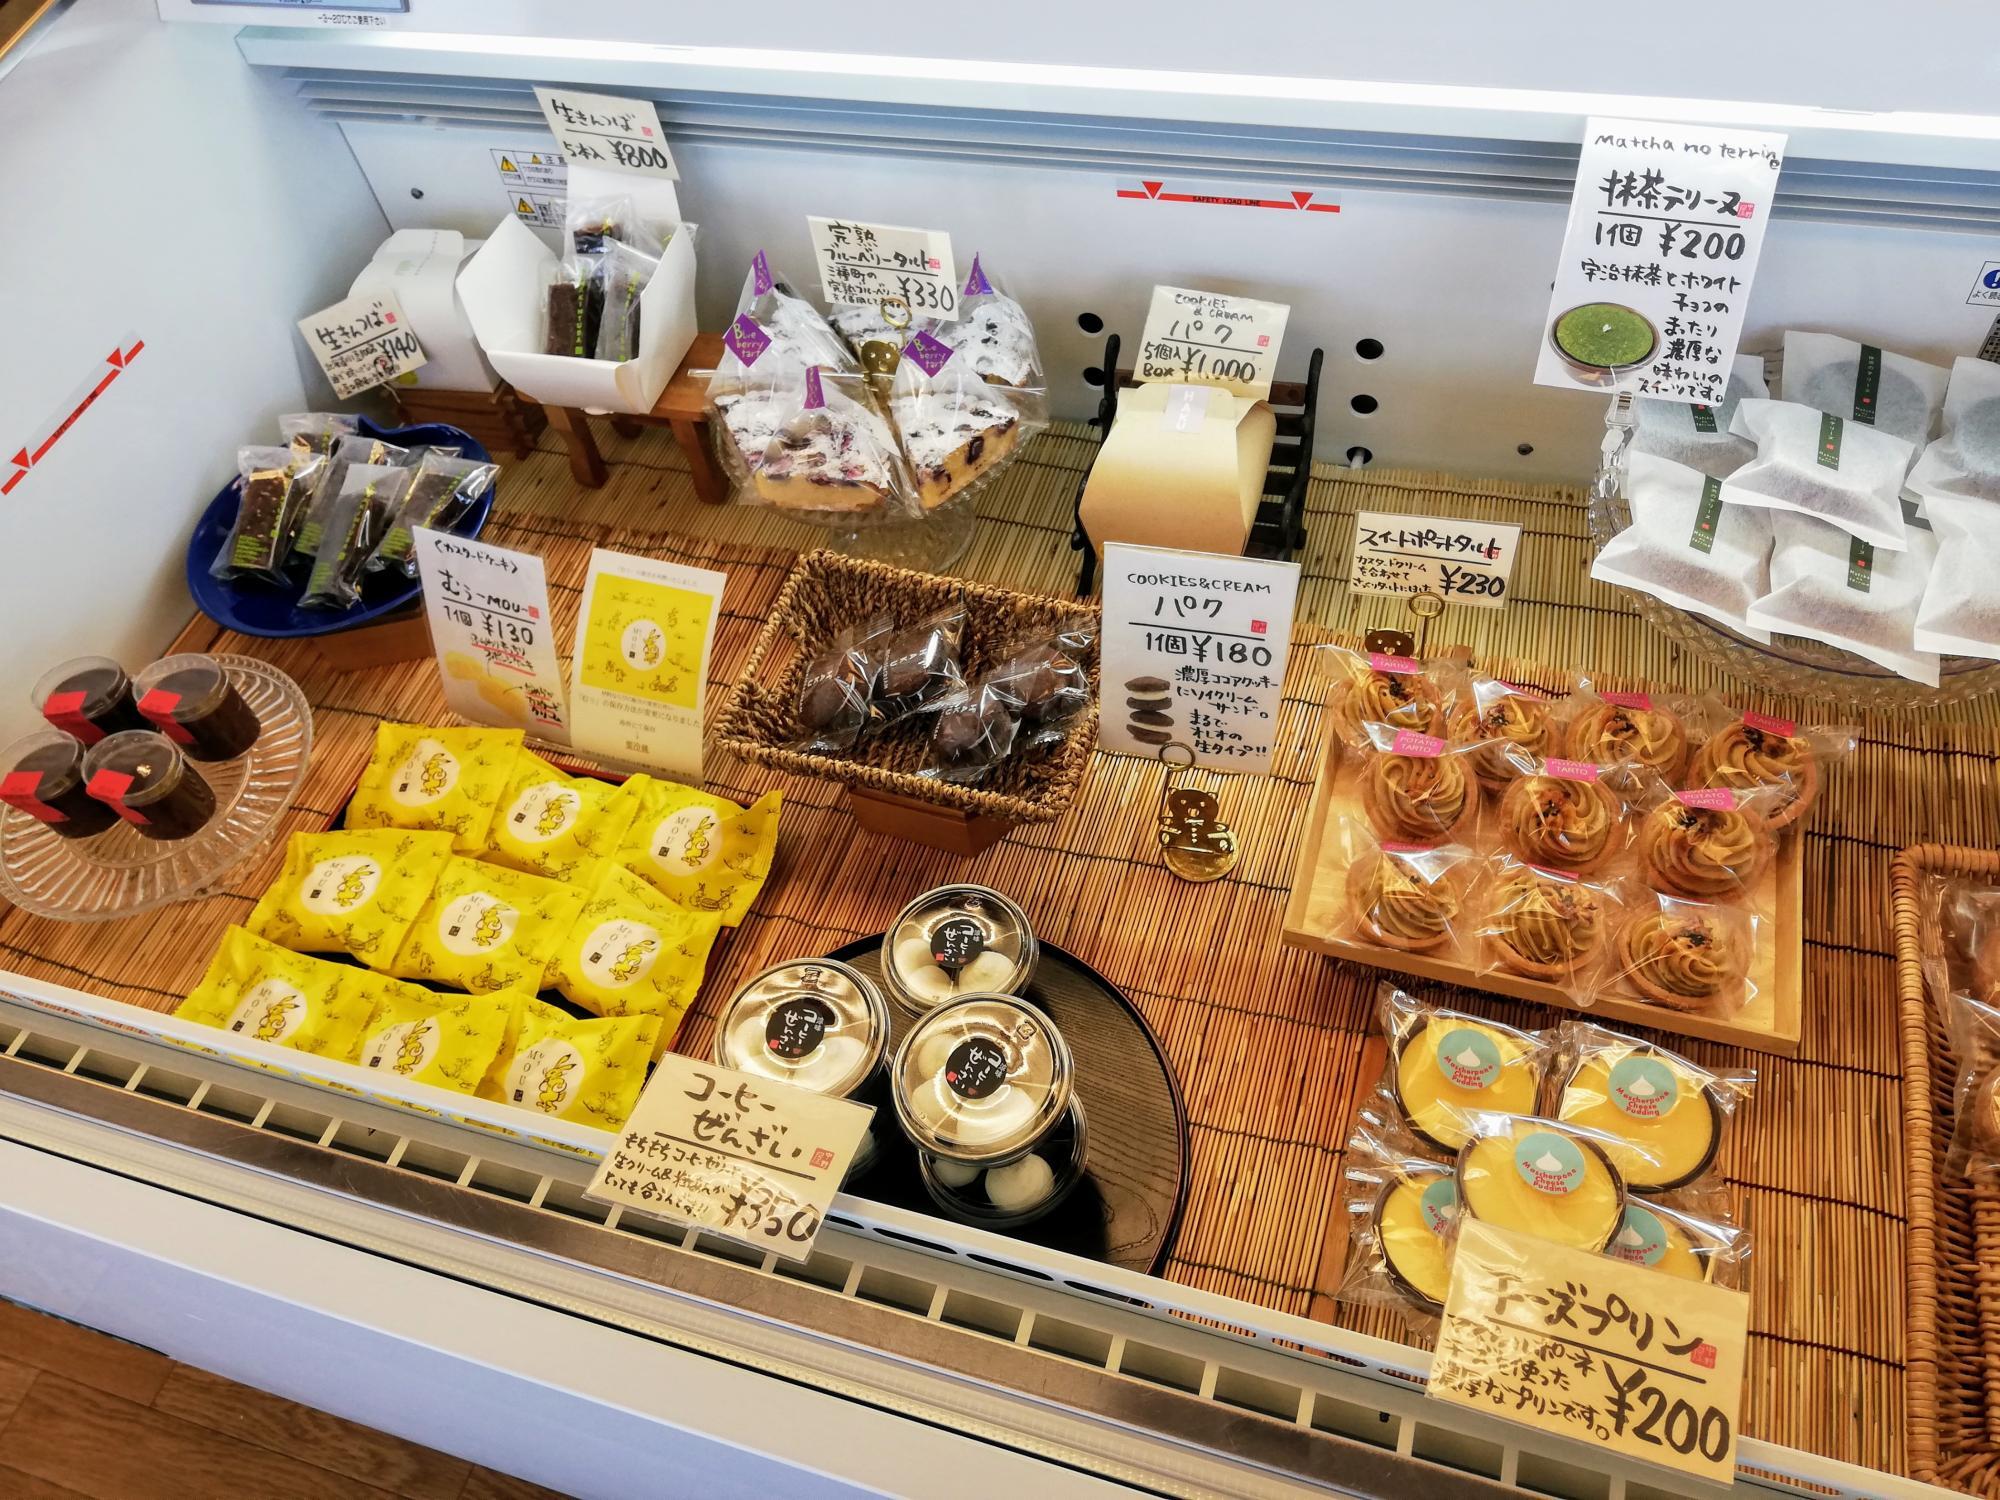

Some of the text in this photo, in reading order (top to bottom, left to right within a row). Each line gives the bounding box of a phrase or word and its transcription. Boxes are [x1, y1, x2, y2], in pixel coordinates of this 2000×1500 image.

[552, 98, 636, 132] 生きんつば
[606, 138, 668, 169] ¥800
[1594, 134, 1674, 152] Matcha
[1683, 142, 1712, 155] no
[1192, 195, 1261, 207] SAFETY LOAD LINE
[1598, 167, 1743, 217] 抹茶テリーヌ
[1594, 222, 1746, 261] 1個 ¥200
[1581, 257, 1741, 294] 宇治抹茶とホワイト
[895, 274, 955, 312] ¥330
[1174, 292, 1230, 310] COOKIES
[315, 300, 386, 352] 生きんつば
[1209, 308, 1254, 324] CREAM
[1664, 316, 1718, 338] まったり
[1169, 319, 1234, 345] パク
[376, 332, 418, 362] ¥140
[1663, 338, 1723, 364] 濃厚な
[1179, 345, 1257, 385] ¥1,000
[1653, 362, 1723, 386] 味わいの
[1127, 572, 1272, 595] COOKIES&CREAM
[1438, 563, 1506, 598] ¥230
[1154, 595, 1224, 618] パク
[443, 605, 534, 646] 1個 ¥130
[1145, 631, 1273, 667] 1個 ¥180
[1174, 664, 1279, 688] 濃厚ココアクッキー
[1188, 708, 1228, 729] まるで
[1400, 736, 1438, 748] POTATO
[1401, 744, 1431, 753] TARTO
[1556, 766, 1588, 776] TARTO
[683, 1072, 776, 1113] コーヒー
[693, 1109, 802, 1158] ぜんざい
[1602, 1358, 1731, 1464] ¥200
